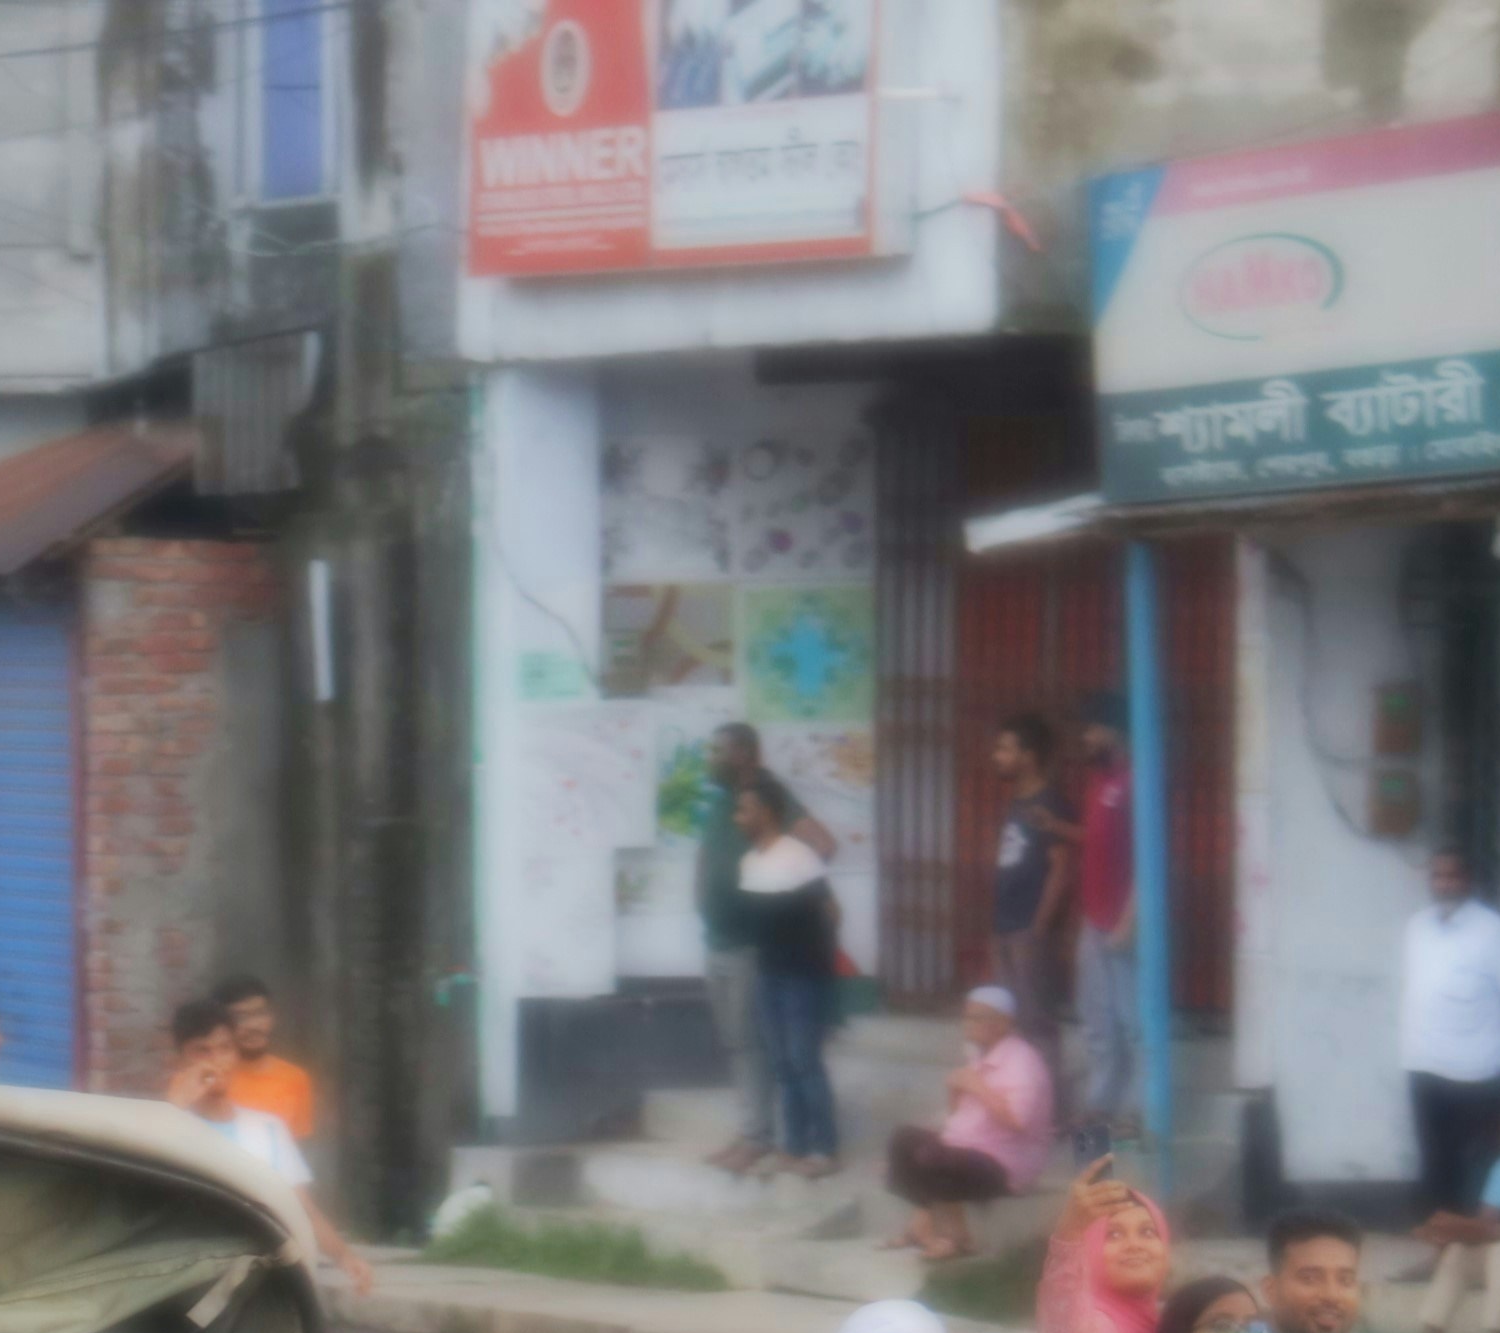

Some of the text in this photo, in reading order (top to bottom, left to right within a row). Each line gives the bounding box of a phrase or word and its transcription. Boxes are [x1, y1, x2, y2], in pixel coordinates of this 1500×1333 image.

[478, 128, 648, 184] WINNER
[1155, 378, 1310, 454] শ্যামলী
[1320, 359, 1486, 436] ব্যাটারী
